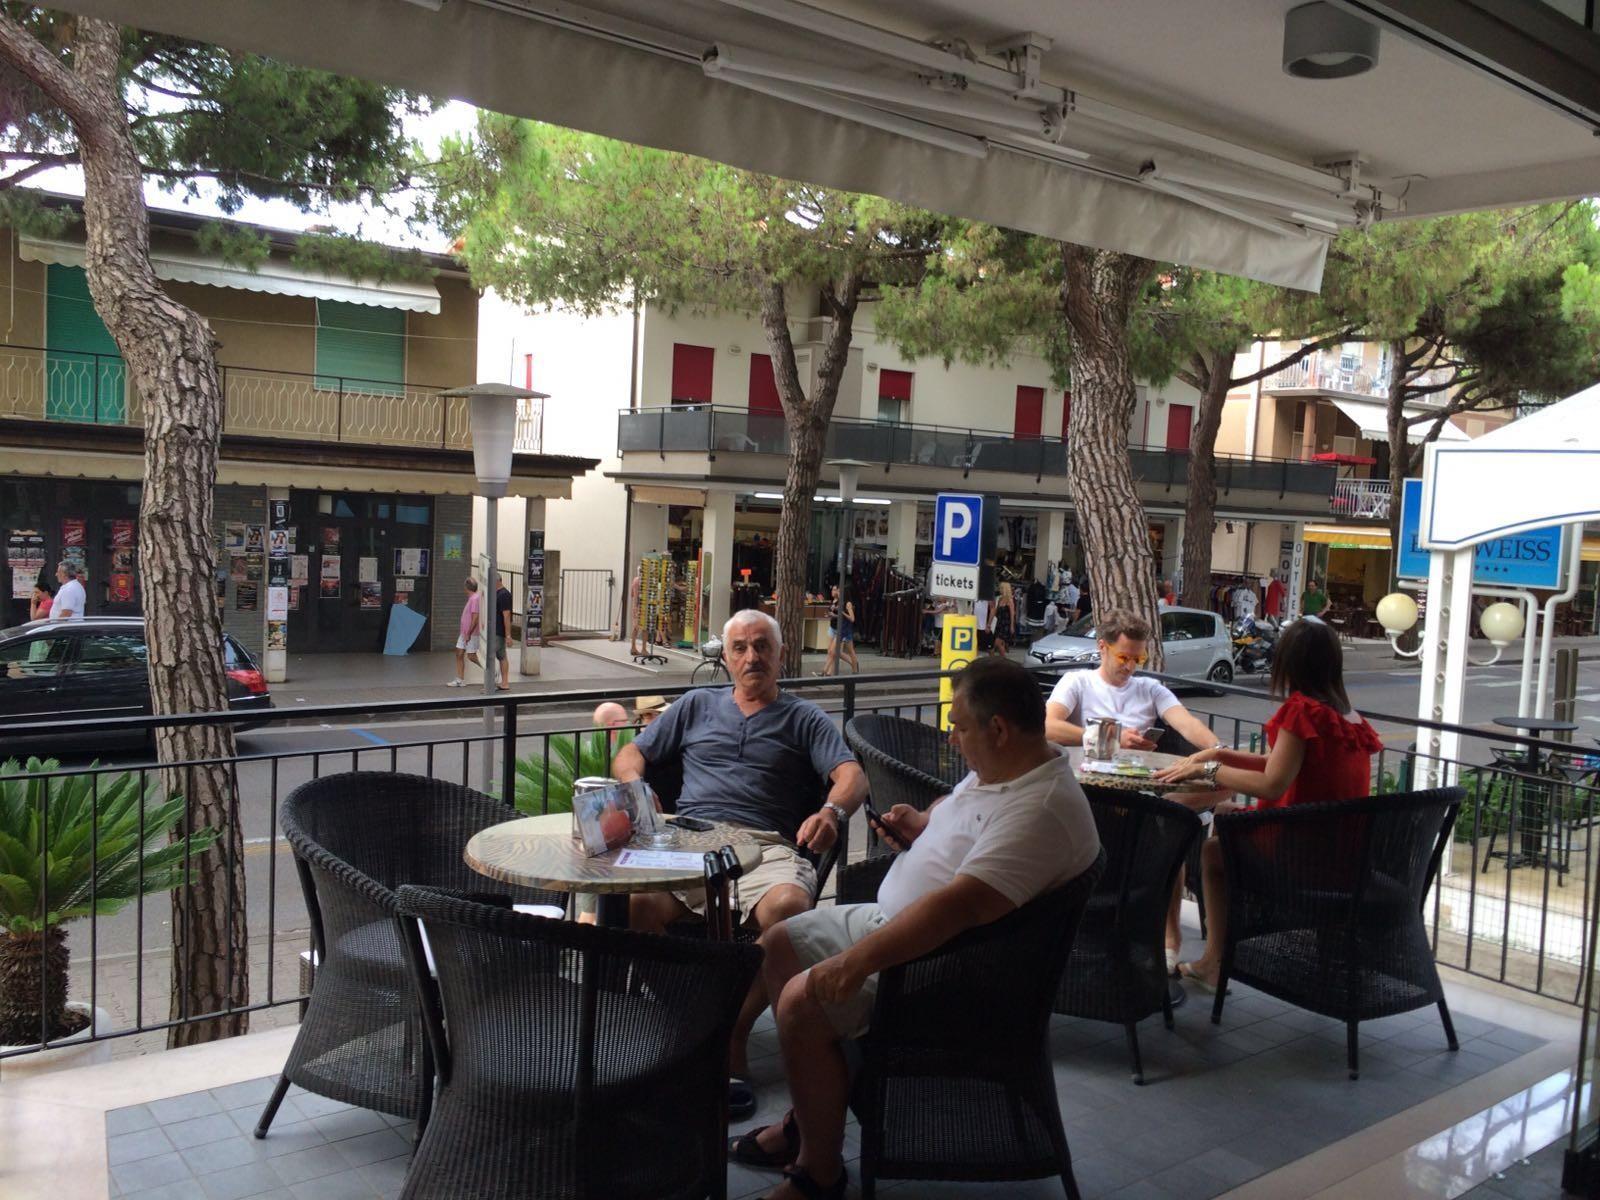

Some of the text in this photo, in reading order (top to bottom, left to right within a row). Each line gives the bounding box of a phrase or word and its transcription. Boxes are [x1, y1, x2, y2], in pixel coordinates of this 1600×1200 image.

[942, 502, 972, 556] P
[1410, 534, 1551, 562] EWEISS
[935, 573, 974, 590] tickets
[954, 628, 971, 649] P
